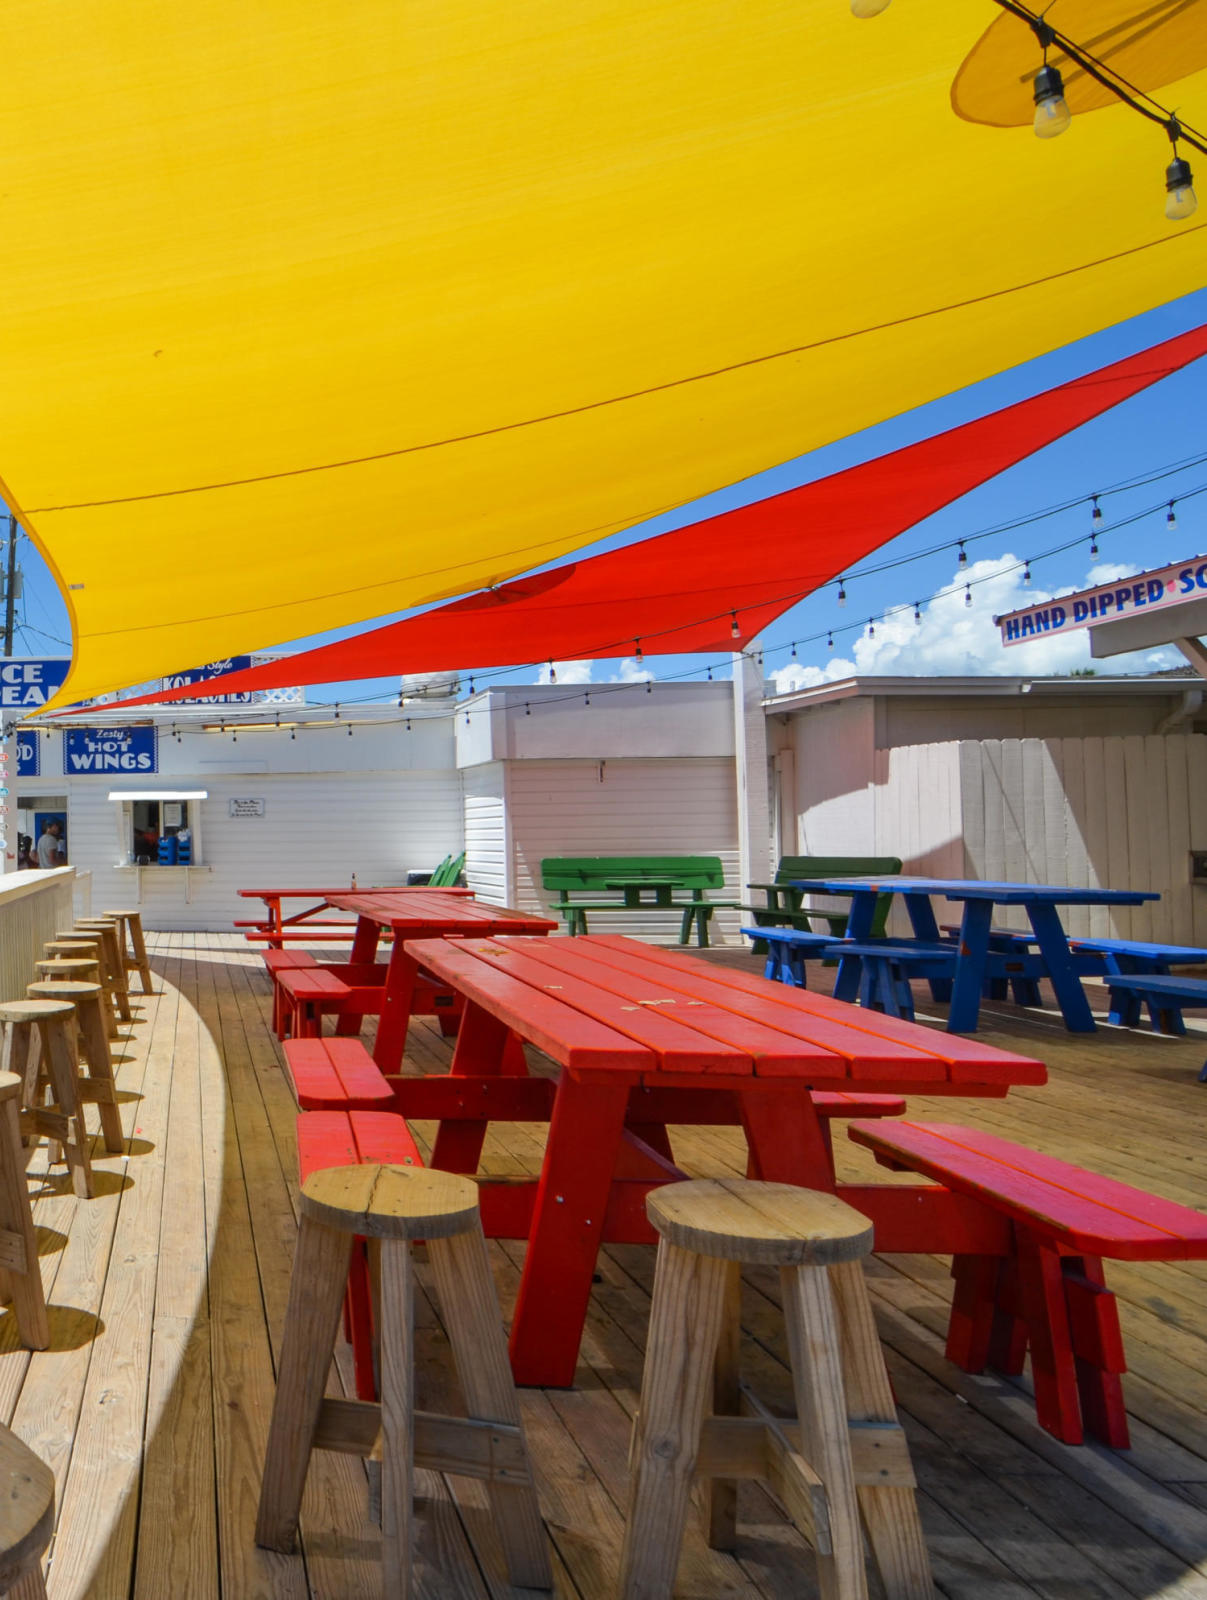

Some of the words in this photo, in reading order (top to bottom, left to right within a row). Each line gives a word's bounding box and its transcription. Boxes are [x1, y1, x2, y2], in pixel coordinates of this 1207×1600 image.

[1006, 606, 1066, 641] HAND
[1073, 578, 1164, 623] DIPPED
[96, 729, 124, 740] Zesty
[88, 741, 132, 752] HOT
[71, 753, 151, 769] WINGS
